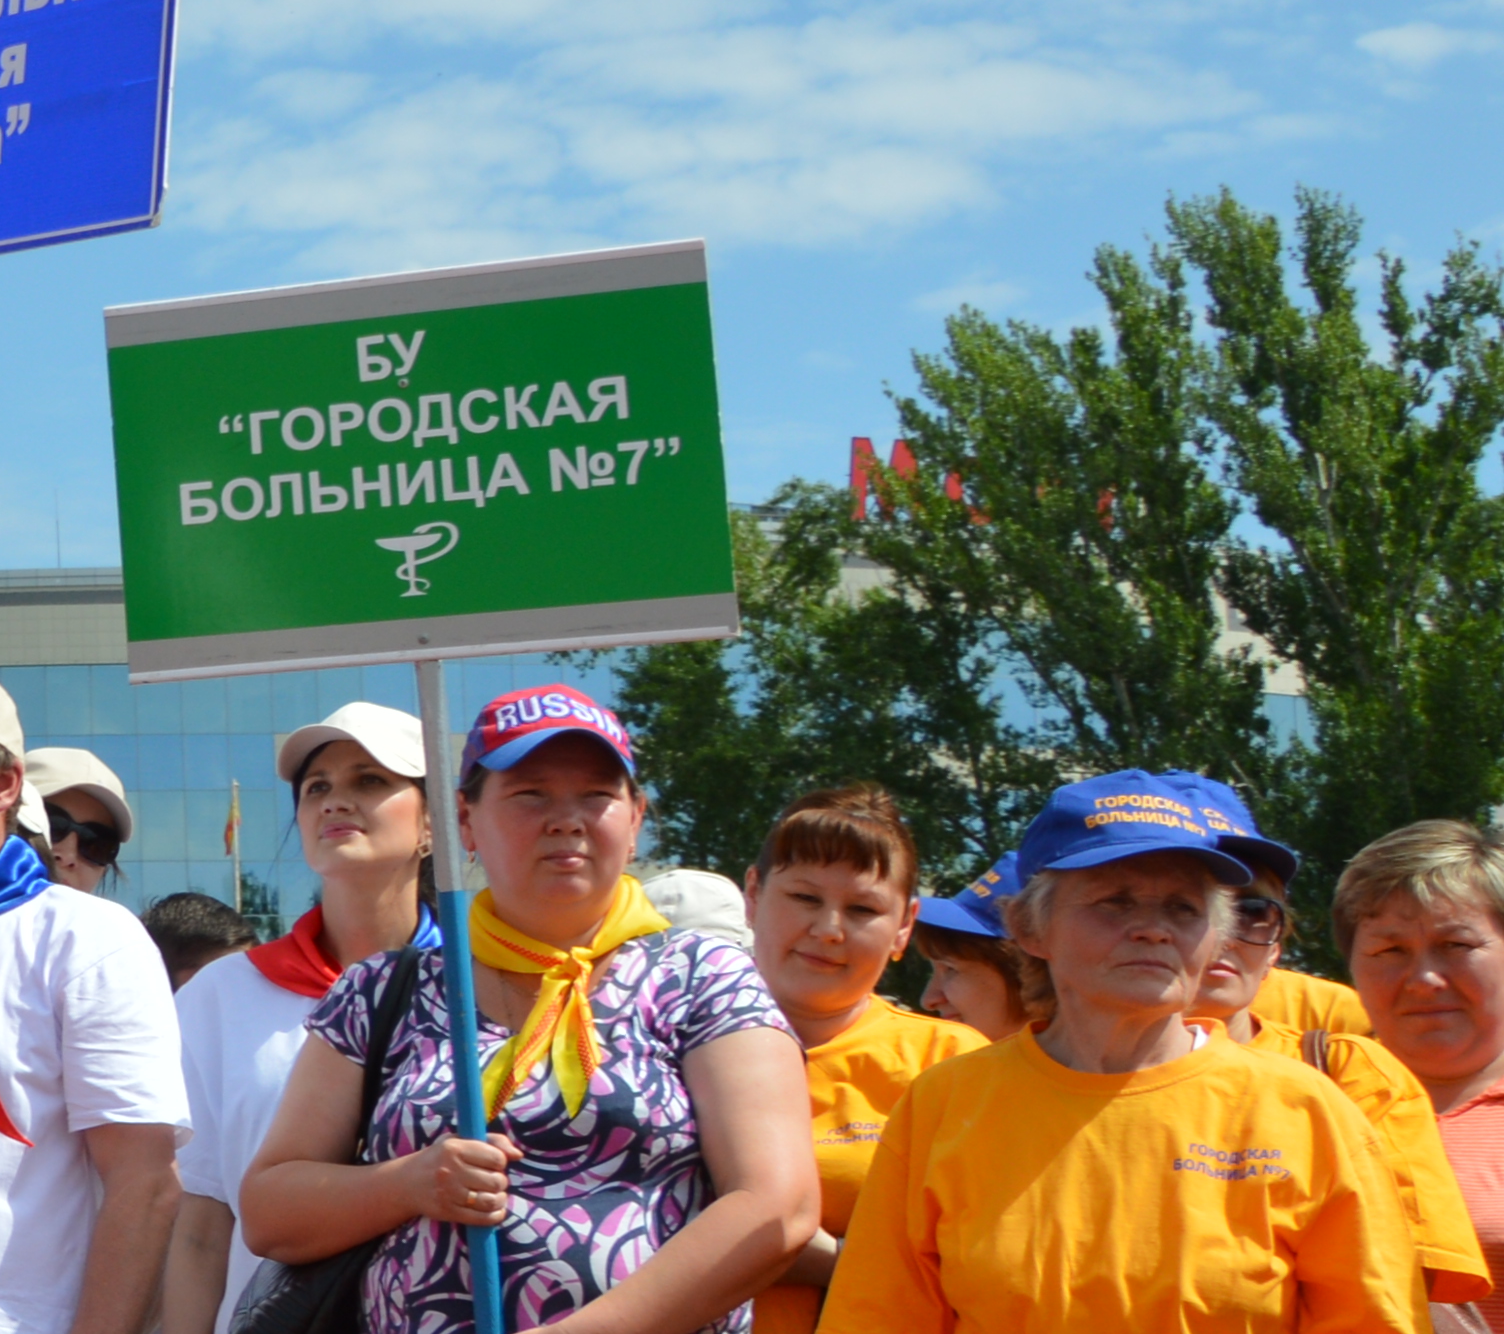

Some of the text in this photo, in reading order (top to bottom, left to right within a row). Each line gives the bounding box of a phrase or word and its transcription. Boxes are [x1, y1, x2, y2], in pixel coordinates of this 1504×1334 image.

[356, 330, 426, 382] БУ
[219, 376, 630, 454] “ГОРОДСКАЯ
[179, 437, 681, 526] БОЛЬНИЦА №7”
[494, 691, 624, 744] RUSSIA
[1084, 810, 1182, 830] БОЛЬНИЦА
[1094, 794, 1193, 818] ГОРОДСКАЯ
